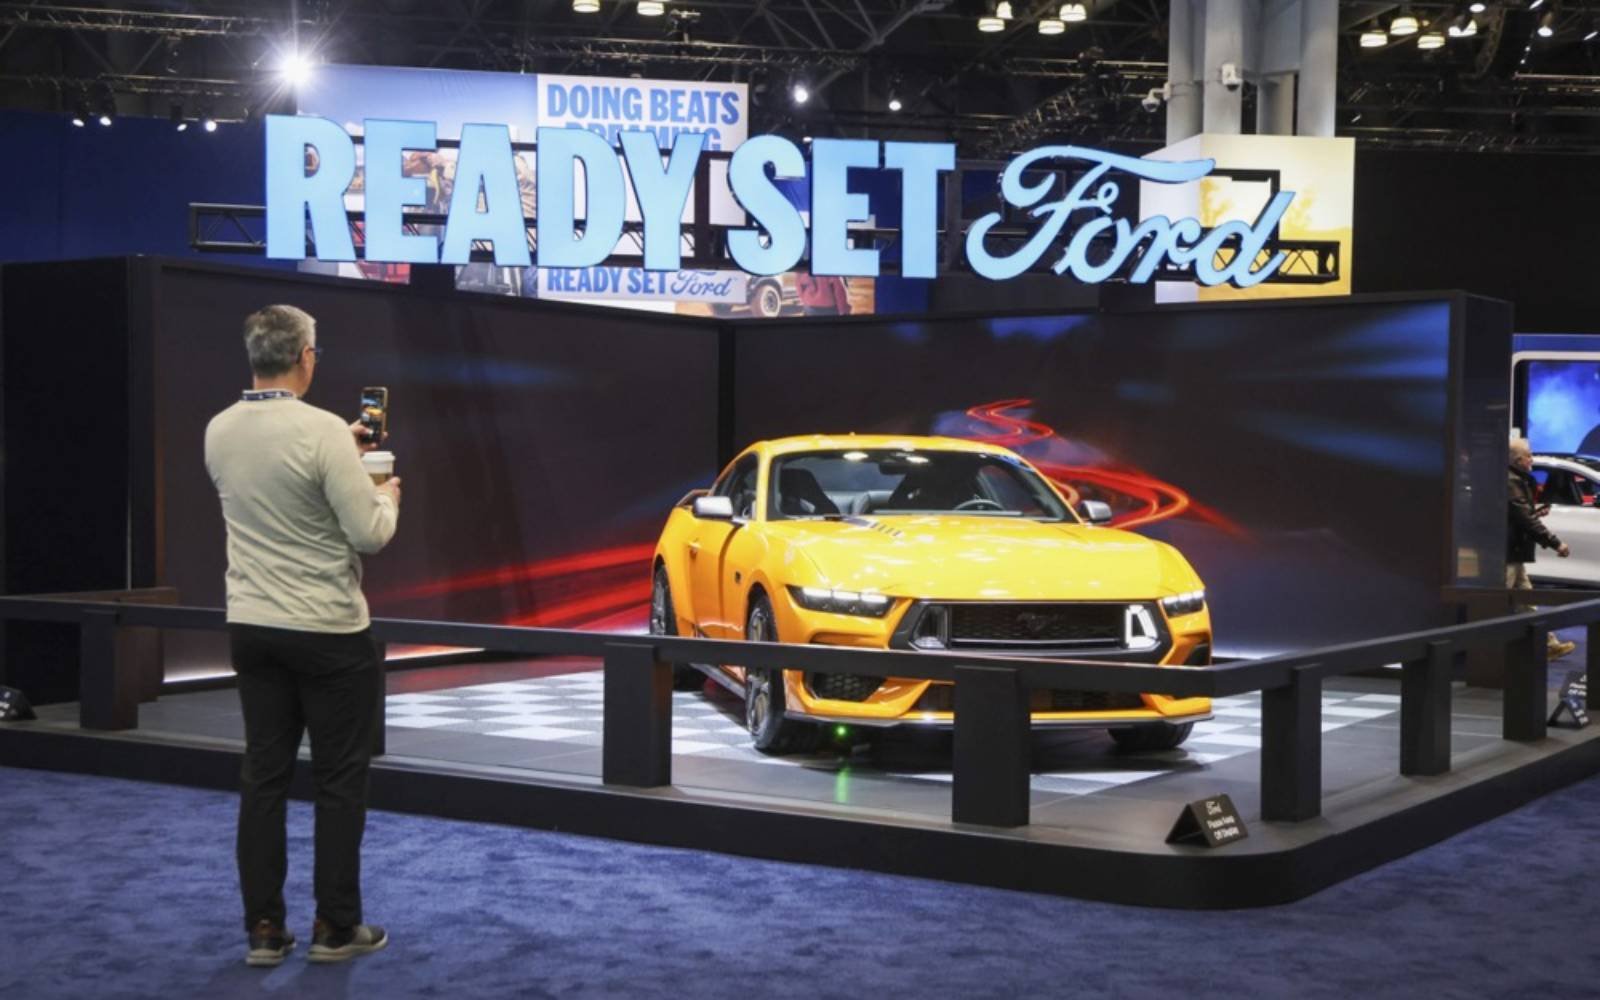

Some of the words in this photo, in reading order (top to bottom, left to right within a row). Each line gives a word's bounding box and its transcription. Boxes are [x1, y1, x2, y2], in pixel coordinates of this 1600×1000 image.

[547, 84, 642, 121] DOING
[650, 88, 740, 125] BEATS
[265, 114, 707, 273] READY
[727, 134, 956, 278] SET
[966, 145, 1296, 288] Ford
[547, 267, 620, 294] READY
[628, 269, 669, 295] SET
[670, 269, 731, 296] Ford
